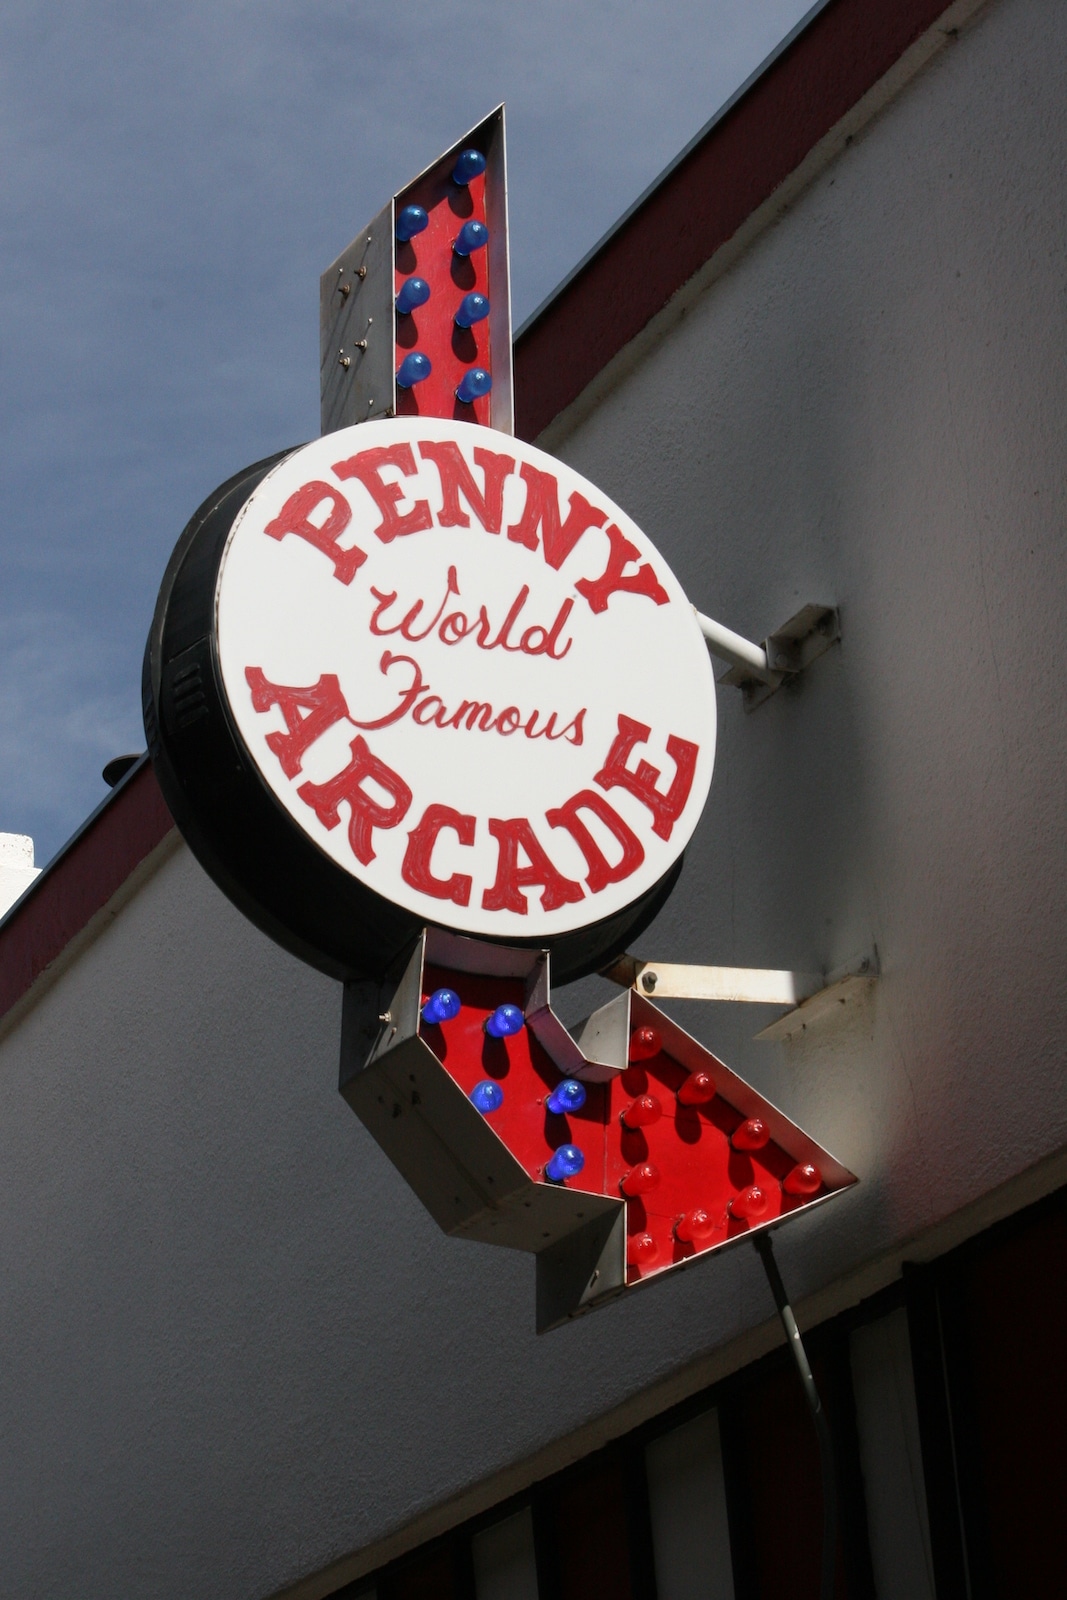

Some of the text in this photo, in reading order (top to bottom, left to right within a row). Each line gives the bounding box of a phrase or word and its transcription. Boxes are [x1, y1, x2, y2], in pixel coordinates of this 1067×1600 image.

[263, 441, 671, 615] PENNY
[368, 564, 574, 661] World
[347, 650, 587, 747] Famous
[244, 666, 700, 916] ARCADE
